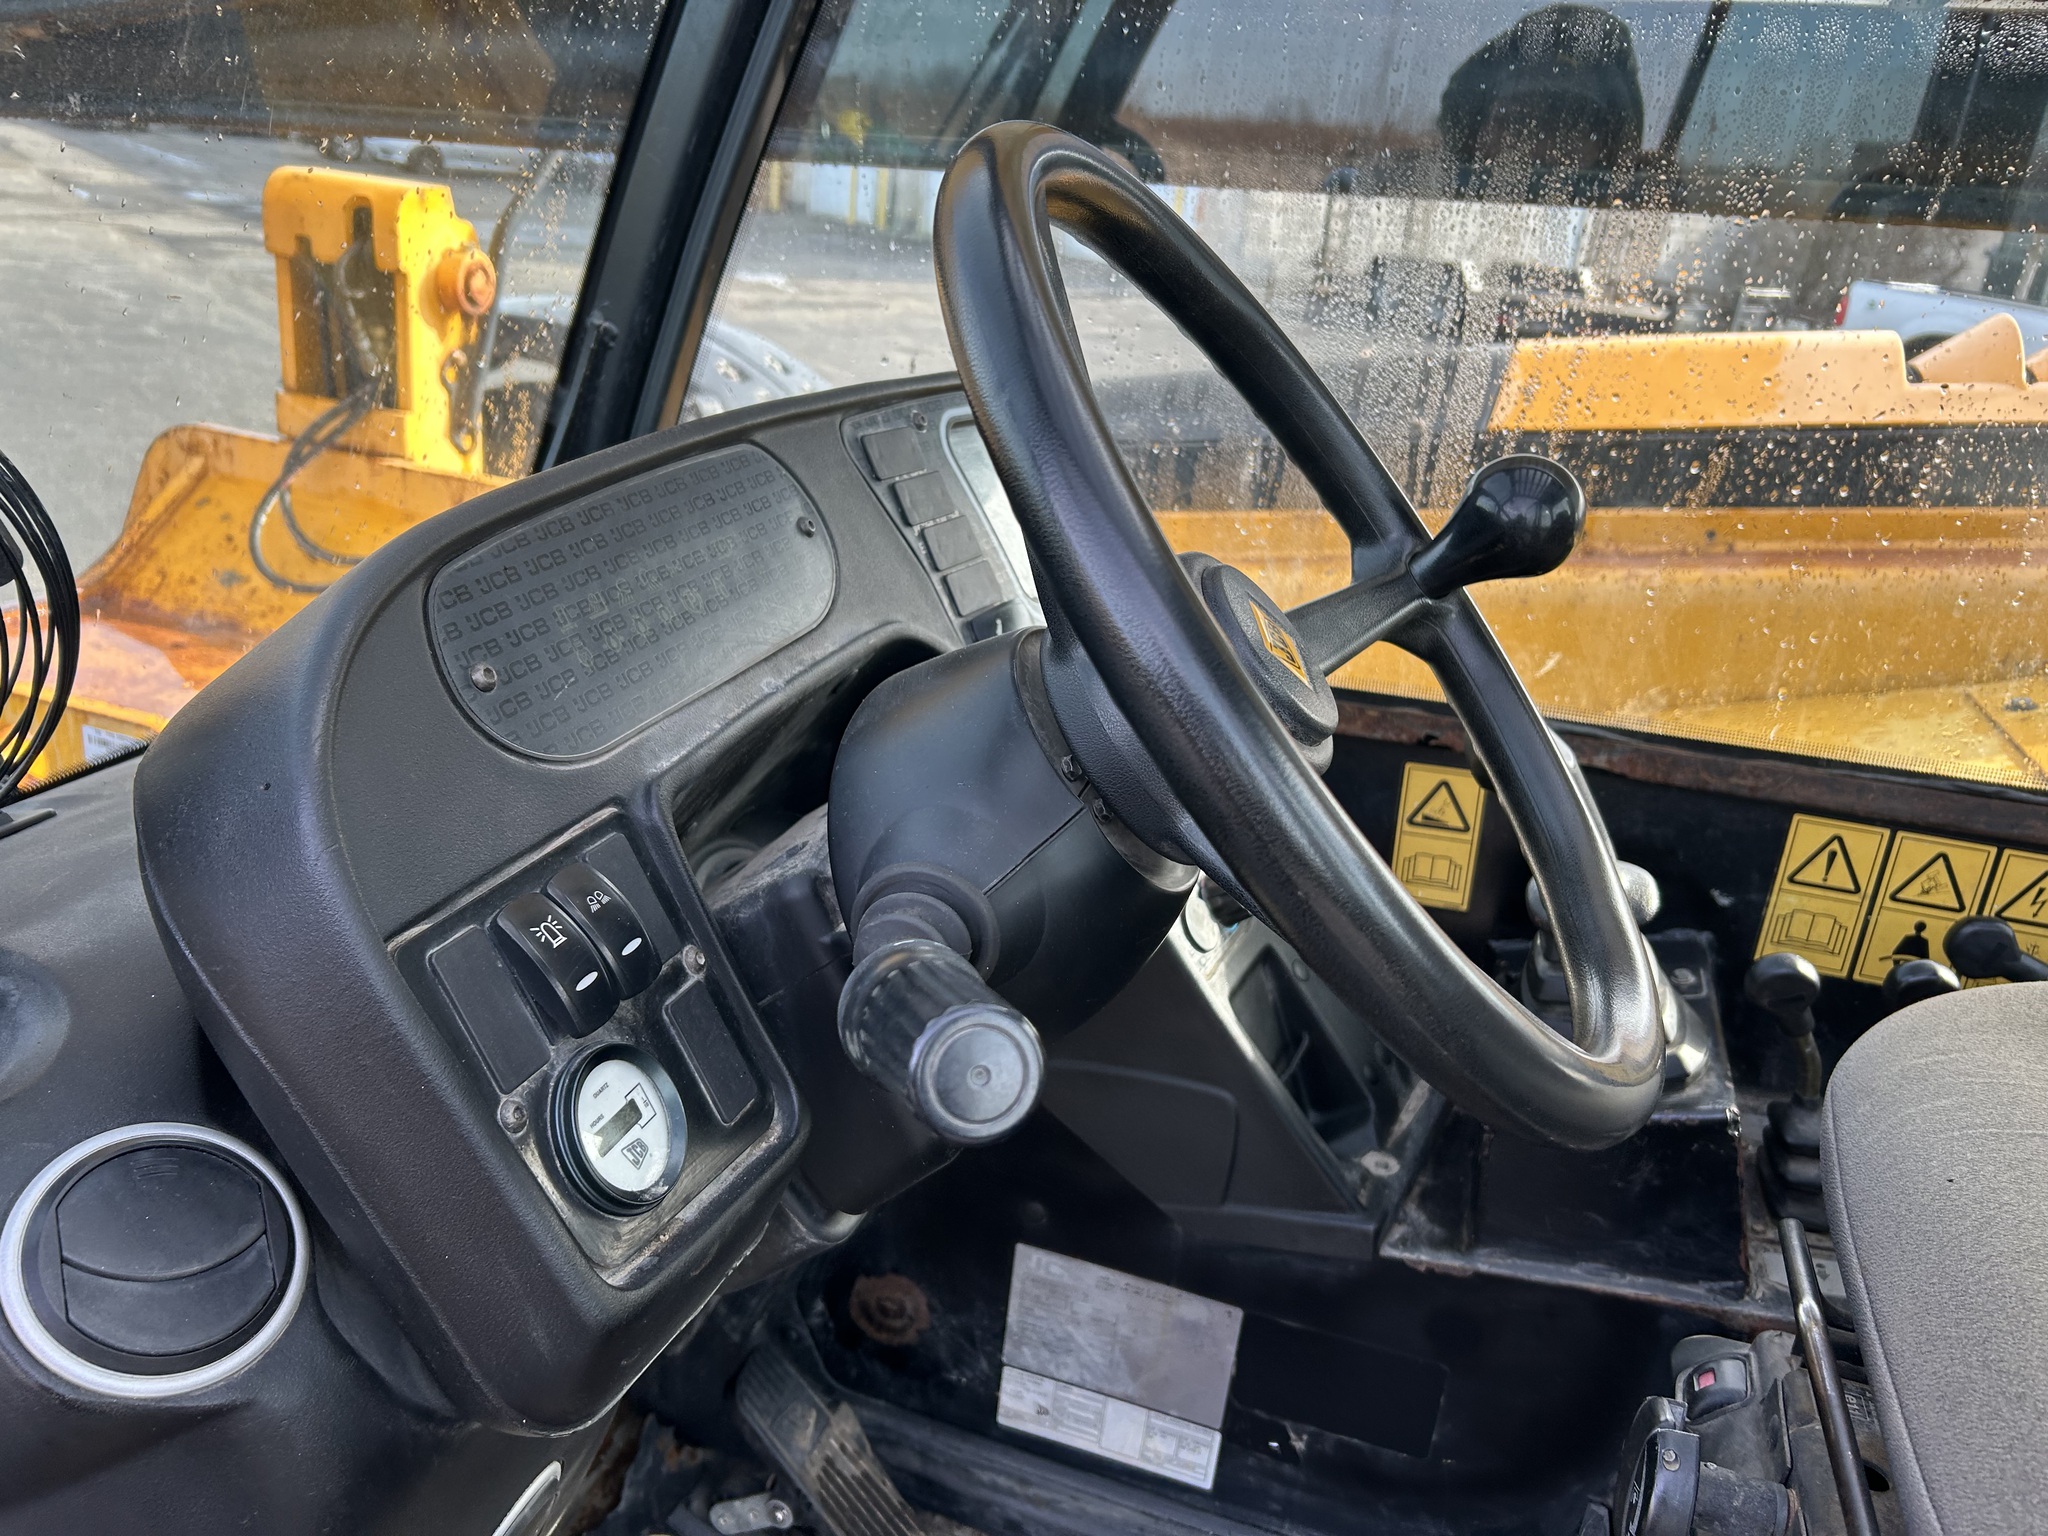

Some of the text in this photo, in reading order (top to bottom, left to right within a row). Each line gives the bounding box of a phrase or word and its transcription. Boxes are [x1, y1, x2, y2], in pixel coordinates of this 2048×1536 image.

[437, 584, 474, 613] CB
[475, 566, 522, 595] JCB
[524, 549, 567, 576] JCB
[569, 533, 608, 559] JCB
[610, 519, 647, 542] JCB
[648, 505, 682, 528] JCB
[683, 492, 715, 514] JCB
[716, 481, 746, 501] JCB
[747, 470, 775, 489] JCB
[533, 516, 575, 542] JCB
[576, 502, 615, 526] JCB
[617, 489, 653, 512] JCB
[654, 477, 687, 498] JCB
[688, 465, 720, 486] JCB
[465, 602, 512, 632] JCB
[515, 583, 559, 611] JCB
[561, 565, 601, 592] JCB
[603, 549, 640, 574] JCB
[642, 534, 677, 558] JCB
[678, 521, 710, 543] JCB
[711, 508, 742, 529] JCB
[742, 496, 771, 516] JCB
[505, 618, 550, 648] JCB
[738, 522, 767, 544] JCB
[486, 691, 532, 725] JCB
[535, 668, 578, 700] JCB
[622, 628, 659, 656] JCB
[660, 610, 695, 636] JCB
[696, 593, 728, 618] JCB
[729, 578, 759, 601] JCB
[500, 654, 541, 686] JCB
[544, 633, 586, 663] JCB
[588, 613, 627, 642] JCB
[629, 596, 665, 622] JCB
[734, 550, 763, 572] JCB
[525, 705, 570, 738] JCB
[572, 682, 613, 713] JCB
[615, 661, 653, 690] JCB
[590, 1113, 604, 1129] HOURS
[592, 1082, 609, 1099] QUARTZ
[626, 1141, 648, 1166] JCB
